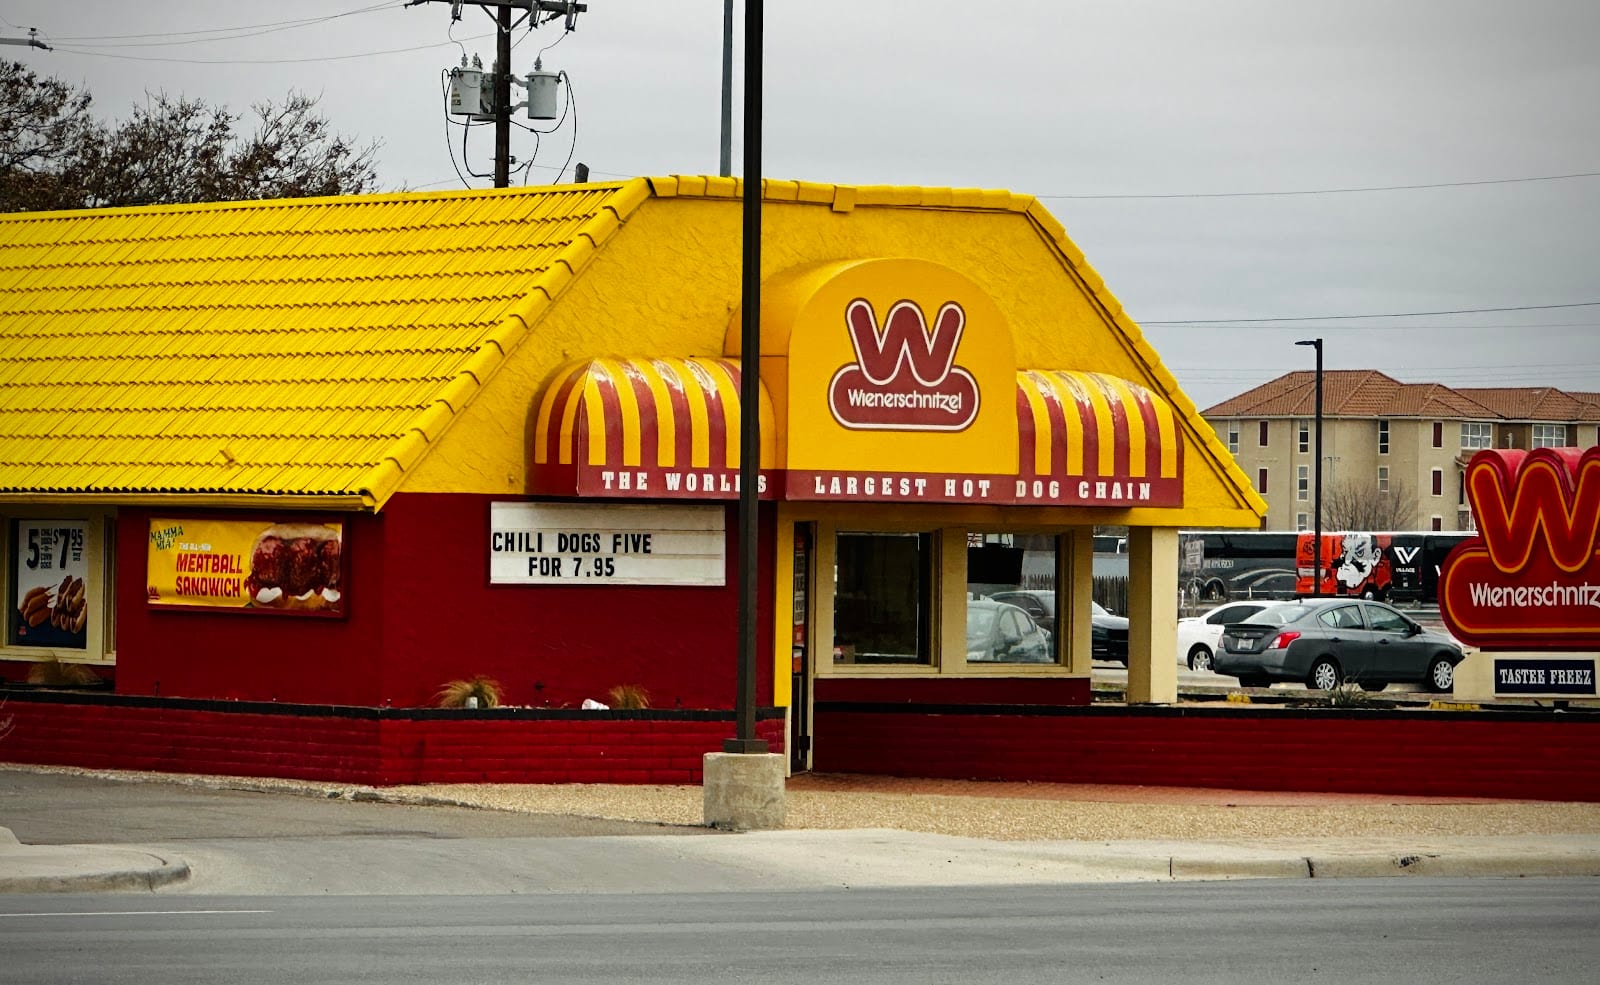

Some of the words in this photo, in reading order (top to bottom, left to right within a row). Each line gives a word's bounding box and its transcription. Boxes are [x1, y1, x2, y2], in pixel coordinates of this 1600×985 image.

[845, 298, 965, 386] W
[847, 389, 962, 414] Wienerschnitzel
[601, 471, 648, 490] THE
[814, 475, 927, 498] LARGEST
[944, 478, 991, 498] HOT
[1015, 480, 1060, 499] DOG
[1078, 480, 1152, 501] CHAIN
[150, 526, 184, 543] MAMMA
[492, 532, 543, 552] CHILI
[558, 533, 601, 553] DOGS
[612, 534, 652, 554] FIVE
[26, 528, 40, 570] 5
[176, 552, 243, 574] MEATBALL
[528, 557, 562, 577] FOR
[573, 558, 616, 577] 7.95
[175, 575, 241, 598] SANDWICH
[1500, 669, 1546, 684] TASTEE
[1549, 669, 1592, 685] FREEZ
